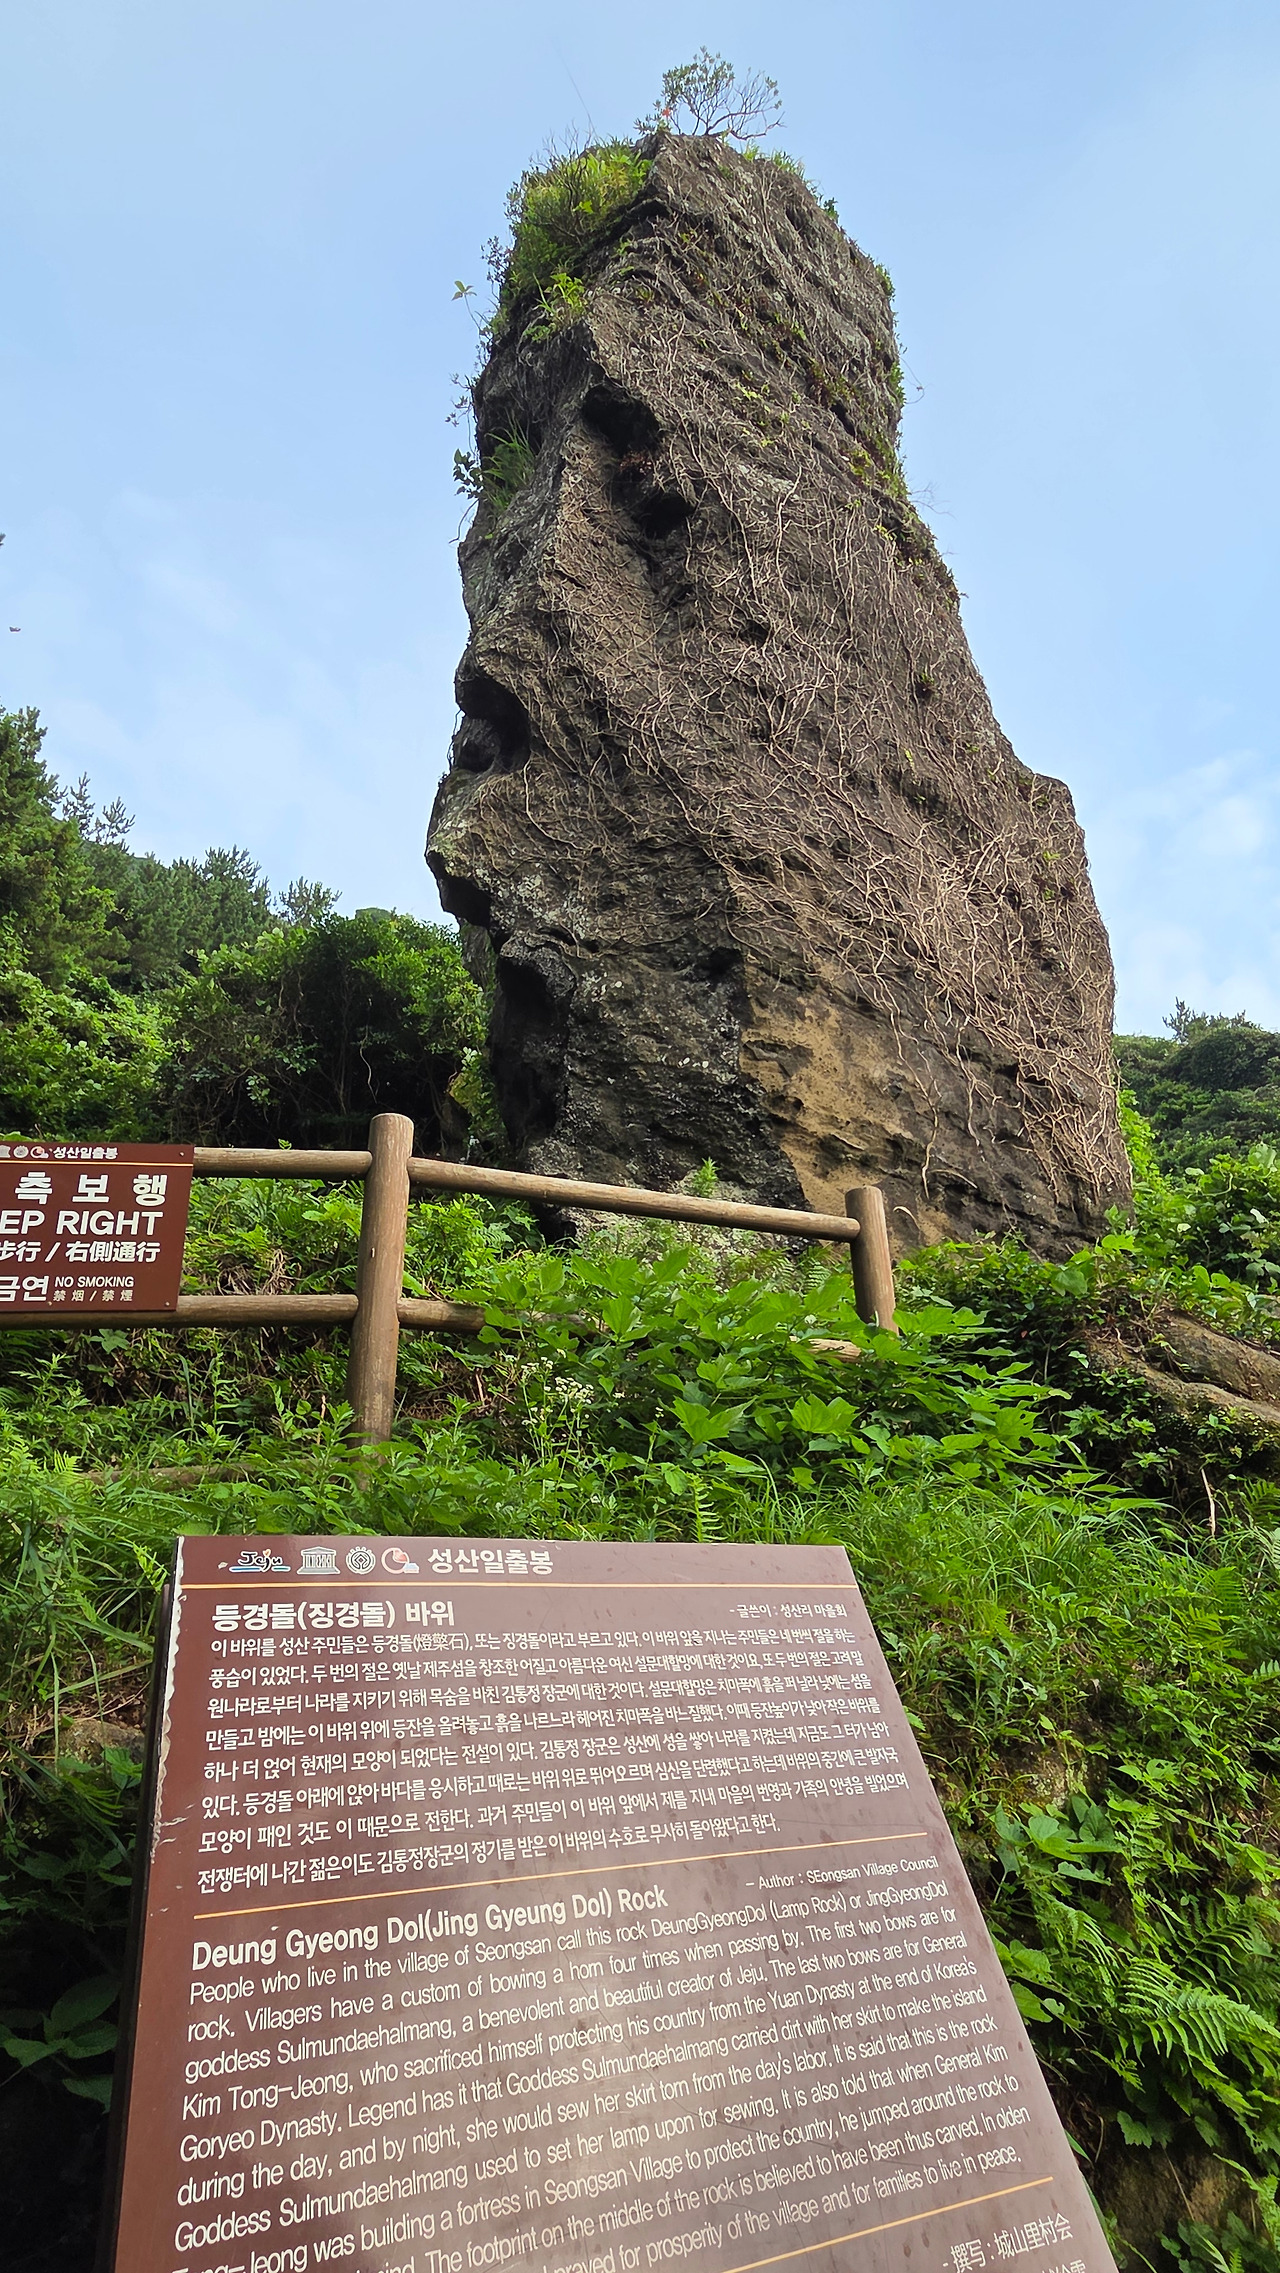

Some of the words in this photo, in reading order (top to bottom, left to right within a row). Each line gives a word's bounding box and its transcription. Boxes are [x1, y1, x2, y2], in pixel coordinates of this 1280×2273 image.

[53, 1146, 118, 1160] 성산일출봉
[56, 1210, 163, 1236] RIGHT
[54, 1276, 74, 1288] NO
[77, 1276, 134, 1288] SMOKING
[237, 1550, 283, 1572] Jeju
[427, 1548, 553, 1575] 성산일출봉
[211, 1600, 396, 1632] 등경돌(징경돌)
[405, 1600, 455, 1627] 바위
[736, 1603, 772, 1619] 글쓴이
[779, 1603, 813, 1618] 성산리
[813, 1603, 848, 1618] 마을회
[210, 1638, 227, 1658] 이
[229, 1637, 277, 1657] 바위를
[278, 1636, 311, 1657] 성산
[310, 1634, 370, 1655] 주민들은
[474, 1632, 502, 1650] 또는
[501, 1631, 577, 1650] 징경돌이라고
[576, 1631, 614, 1648] 부르고
[613, 1630, 643, 1648] 있다.
[641, 1630, 655, 1647] 이
[654, 1630, 680, 1646] 바위
[702, 1629, 738, 1646] 지나는
[737, 1628, 780, 1645] 주민들은
[811, 1627, 835, 1644] 절을
[833, 1628, 856, 1643] 하는
[197, 1827, 252, 1854] 모양이
[256, 1823, 292, 1848] 패인
[297, 1820, 332, 1846] 것도
[335, 1817, 352, 1840] 이
[357, 1812, 421, 1838] 때문으로
[424, 1807, 474, 1832] 전한다.
[477, 1804, 507, 1826] 과거
[510, 1799, 567, 1824] 주민들이
[569, 1797, 586, 1818] 이
[587, 1795, 616, 1816] 바위
[618, 1791, 659, 1815] 앞에서
[659, 1790, 688, 1810] 제를
[688, 1786, 717, 1807] 지내
[717, 1784, 756, 1805] 마을의
[755, 1781, 793, 1802] 번영과
[792, 1778, 830, 1798] 가족의
[828, 1775, 865, 1796] 안녕을
[863, 1772, 910, 1793] 빌었으며
[196, 1862, 268, 1894] 전쟁터에
[271, 1858, 308, 1884] 나간
[308, 1852, 375, 1882] 젊은이도
[376, 1841, 469, 1874] 김통정장군의
[470, 1837, 517, 1864] 정기를
[516, 1834, 548, 1858] 받은
[548, 1832, 564, 1854] 이
[564, 1828, 607, 1852] 바위의
[607, 1825, 650, 1849] 수호로
[649, 1820, 690, 1844] 무사히
[688, 1815, 753, 1840] 돌아왔다고
[750, 1812, 781, 1834] 한다.
[758, 1874, 795, 1890] Author
[805, 1867, 862, 1884] SEongsan
[860, 1862, 899, 1877] Village
[899, 1855, 939, 1872] Council
[189, 1975, 255, 2005] People
[260, 1970, 301, 1994] who
[307, 1965, 337, 1988] live
[342, 1960, 358, 1983] in
[363, 1956, 392, 1979] the
[396, 1951, 449, 1974] village
[453, 1943, 470, 1966] of
[474, 1937, 552, 1963] Seongsan
[556, 1928, 582, 1951] call
[585, 1925, 612, 1947] this
[615, 1920, 649, 1942] rock
[650, 1903, 768, 1937] DeungGyeongDol
[769, 1899, 810, 1922] (Lamp
[810, 1890, 847, 1914] Rock)
[848, 1894, 862, 1909] or
[865, 1879, 949, 1908] JingGyeongDol
[191, 1938, 277, 1971] Deung
[285, 1925, 379, 1960] Gyeong
[386, 1909, 479, 1944] Dol(Jing
[484, 1901, 567, 1933] Gyeung
[571, 1888, 612, 1919] Dol)
[617, 1884, 669, 1913] Rock
[184, 2047, 271, 2084] goddess
[276, 2018, 457, 2064] Sulmundaehalmang,
[461, 2014, 474, 2033] a
[478, 1996, 566, 2030] benevolent
[568, 1988, 600, 2014] and
[602, 1978, 664, 2008] beautiful
[666, 1973, 715, 1997] creator
[718, 1966, 733, 1987] of
[736, 1964, 768, 1986] Jeju.
[767, 1958, 796, 1978] The
[796, 1954, 822, 1974] last
[821, 1952, 846, 1970] two
[845, 1948, 881, 1966] bows
[882, 1944, 903, 1961] are
[903, 1939, 920, 1957] for
[921, 1930, 968, 1954] General
[174, 2209, 271, 2252] Goddess
[278, 2164, 468, 2227] Sulmundaehalmang
[474, 2147, 518, 2180] used
[523, 2146, 541, 2169] to
[546, 2136, 573, 2164] set
[576, 2133, 604, 2157] her
[609, 2124, 650, 2149] lamp
[654, 2114, 695, 2141] upon
[697, 2106, 718, 2129] for
[723, 2096, 779, 2124] sewing.
[780, 2088, 792, 2110] It
[792, 2085, 808, 2107] is
[810, 2080, 839, 2103] also
[840, 2071, 868, 2096] told
[868, 2066, 896, 2090] that
[895, 2061, 934, 2083] when
[934, 2046, 983, 2075] General
[981, 2043, 1009, 2064] Kim
[618, 2244, 641, 2271] for
[645, 2220, 722, 2268] prosperity
[727, 2212, 743, 2239] of
[743, 2209, 770, 2234] the
[771, 2198, 820, 2224] village
[821, 2184, 852, 2214] and
[850, 2181, 871, 2205] for
[872, 2168, 924, 2198] families
[922, 2164, 939, 2185] to
[936, 2158, 963, 2181] live
[960, 2152, 978, 2174] in
[976, 2145, 1022, 2174] peace.
